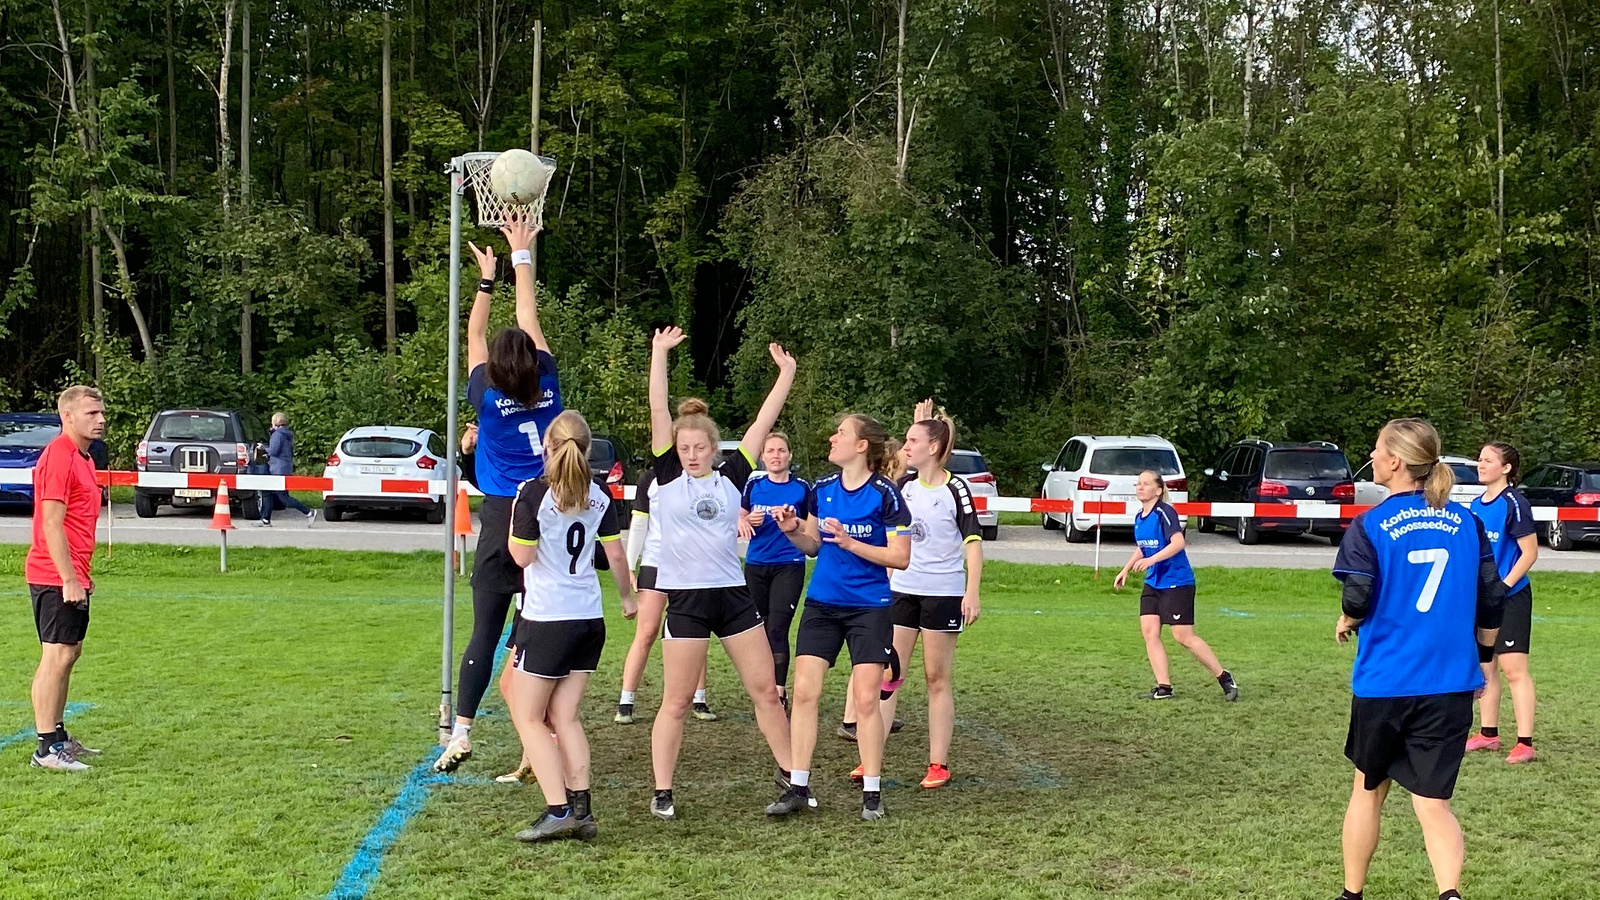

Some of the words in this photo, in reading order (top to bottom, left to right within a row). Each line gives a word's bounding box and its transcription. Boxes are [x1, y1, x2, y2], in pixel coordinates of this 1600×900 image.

[518, 421, 544, 456] 1
[1379, 507, 1462, 532] Korbballclub
[1389, 520, 1460, 541] Moosseedorf
[567, 522, 585, 575] 9
[1407, 548, 1449, 613] 7
